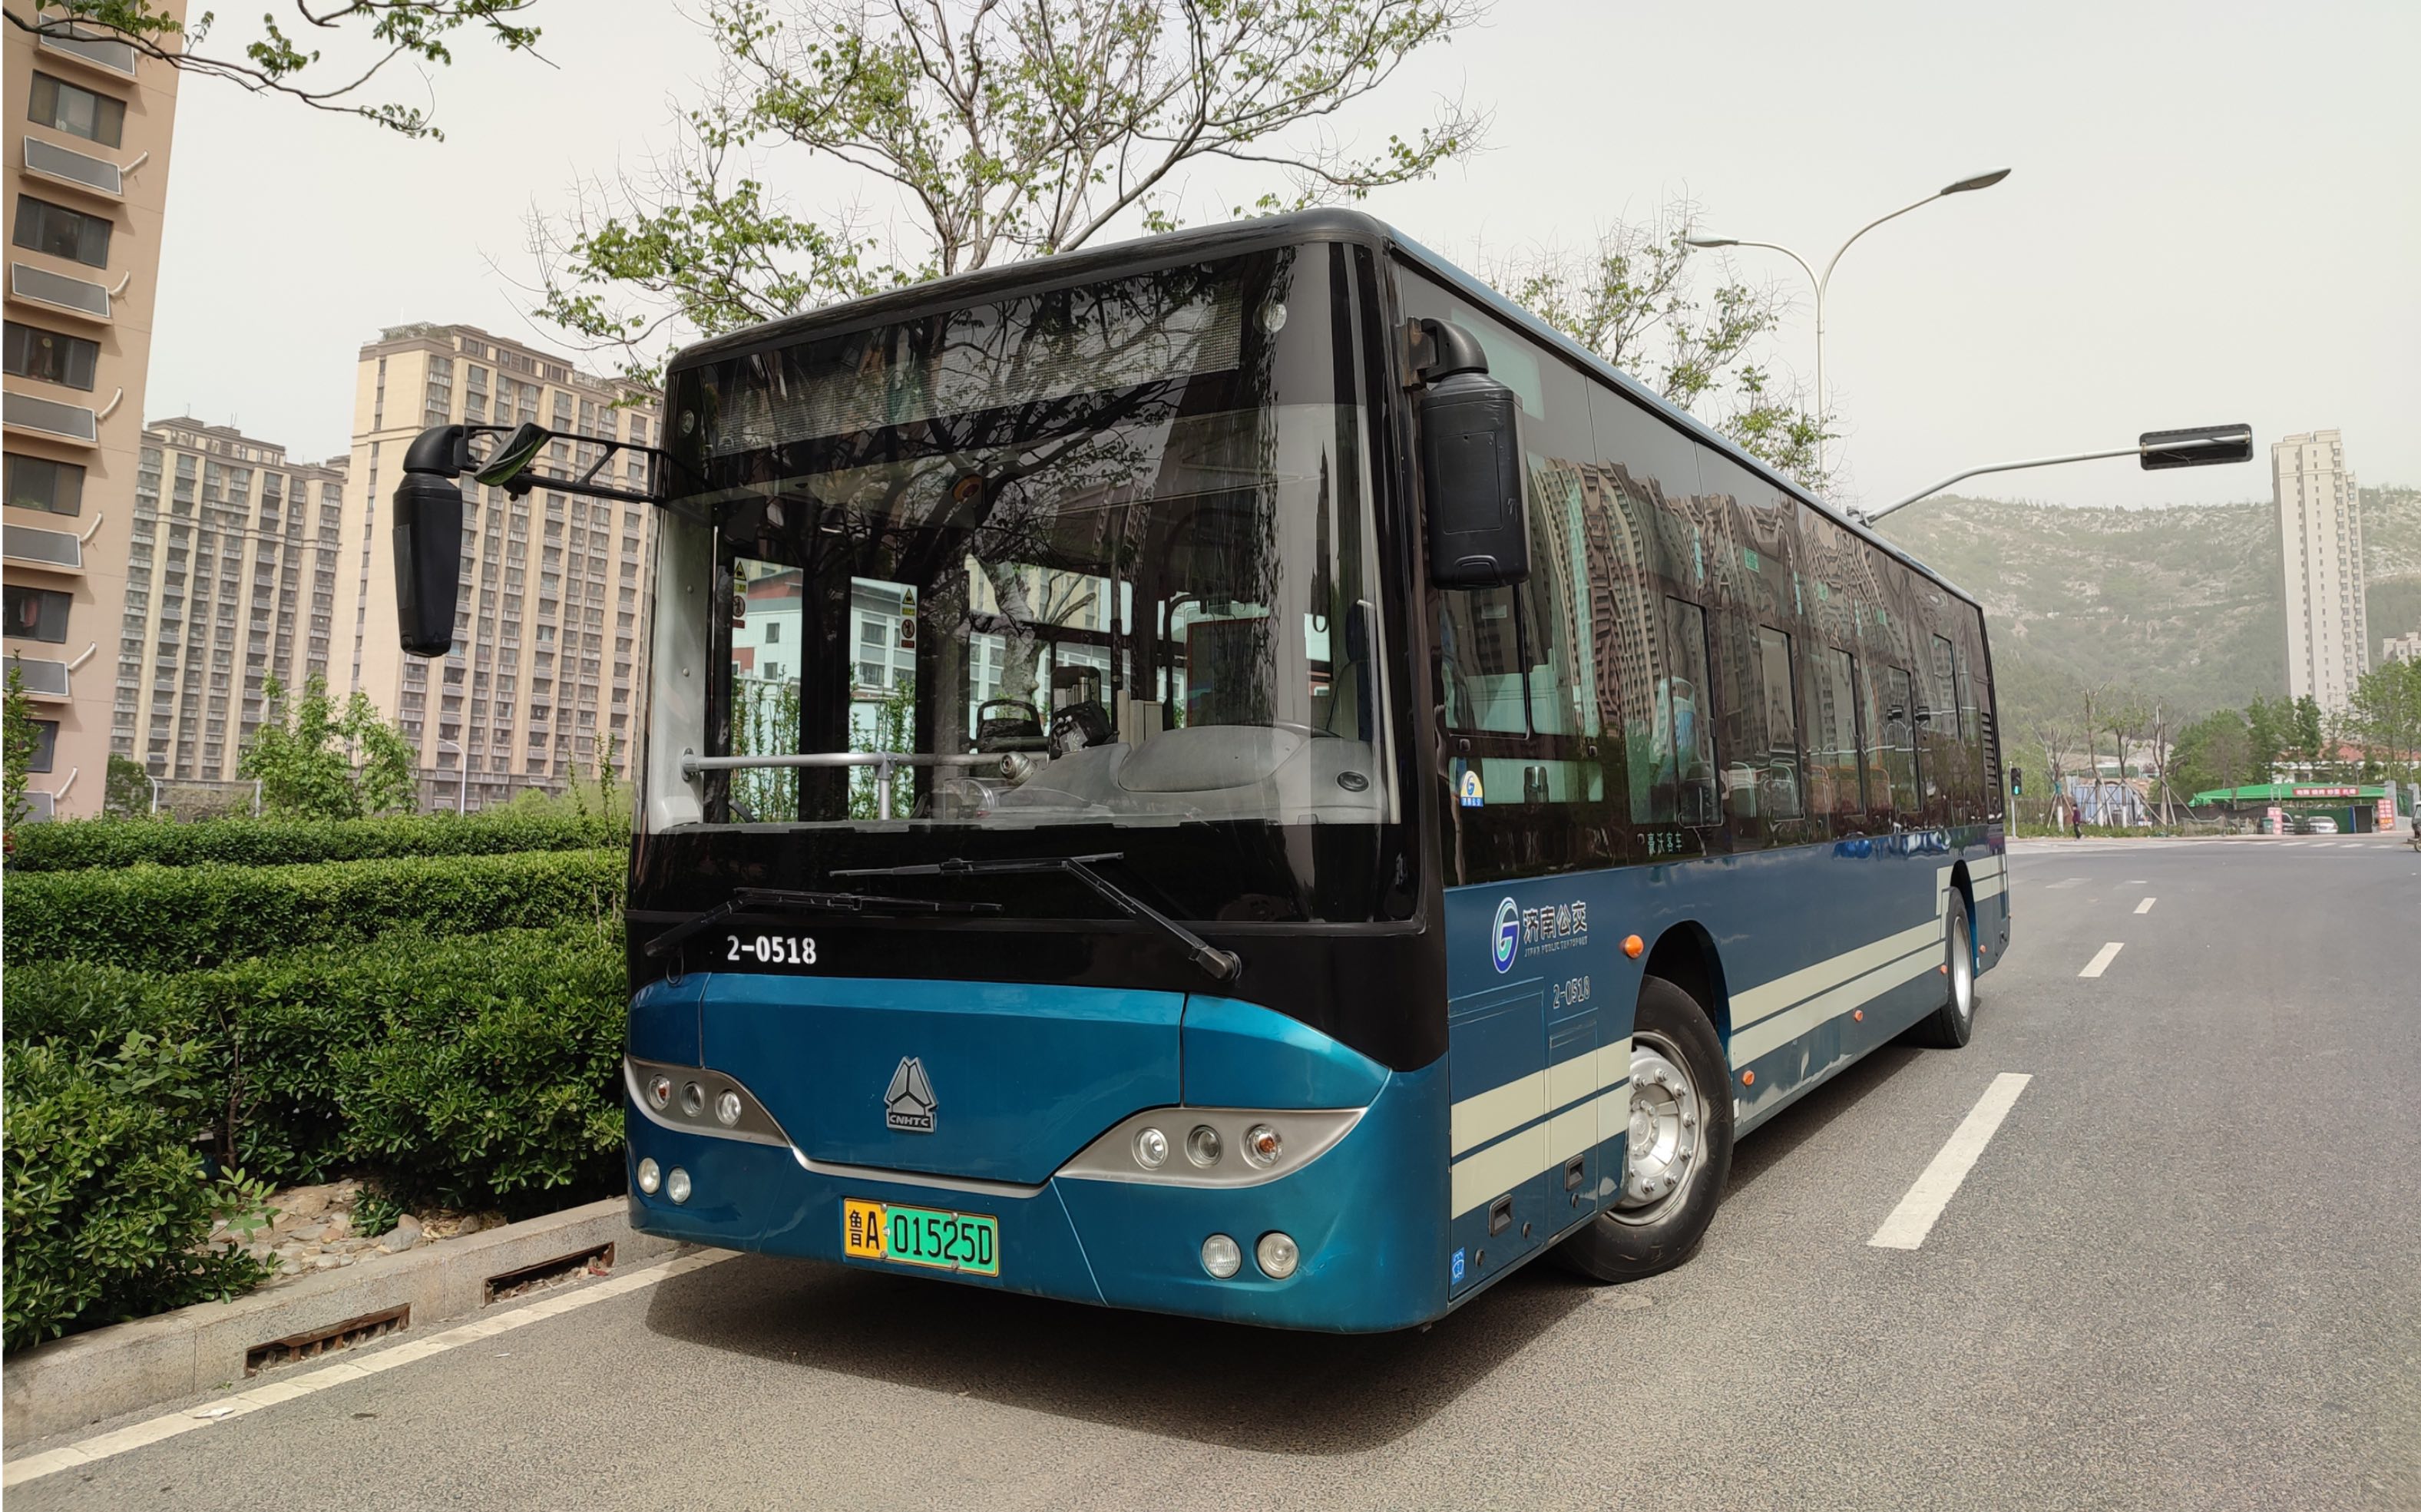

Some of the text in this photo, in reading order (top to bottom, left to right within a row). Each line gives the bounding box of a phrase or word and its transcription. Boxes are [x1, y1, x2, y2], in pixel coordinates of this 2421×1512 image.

[1647, 831, 1682, 857] 豪沃客车
[1523, 900, 1588, 945] 济南公交
[727, 935, 817, 964] 2-0518
[1553, 975, 1591, 1010] 2-0518
[889, 1114, 930, 1127] CNHTC
[893, 1215, 993, 1265] 01525D
